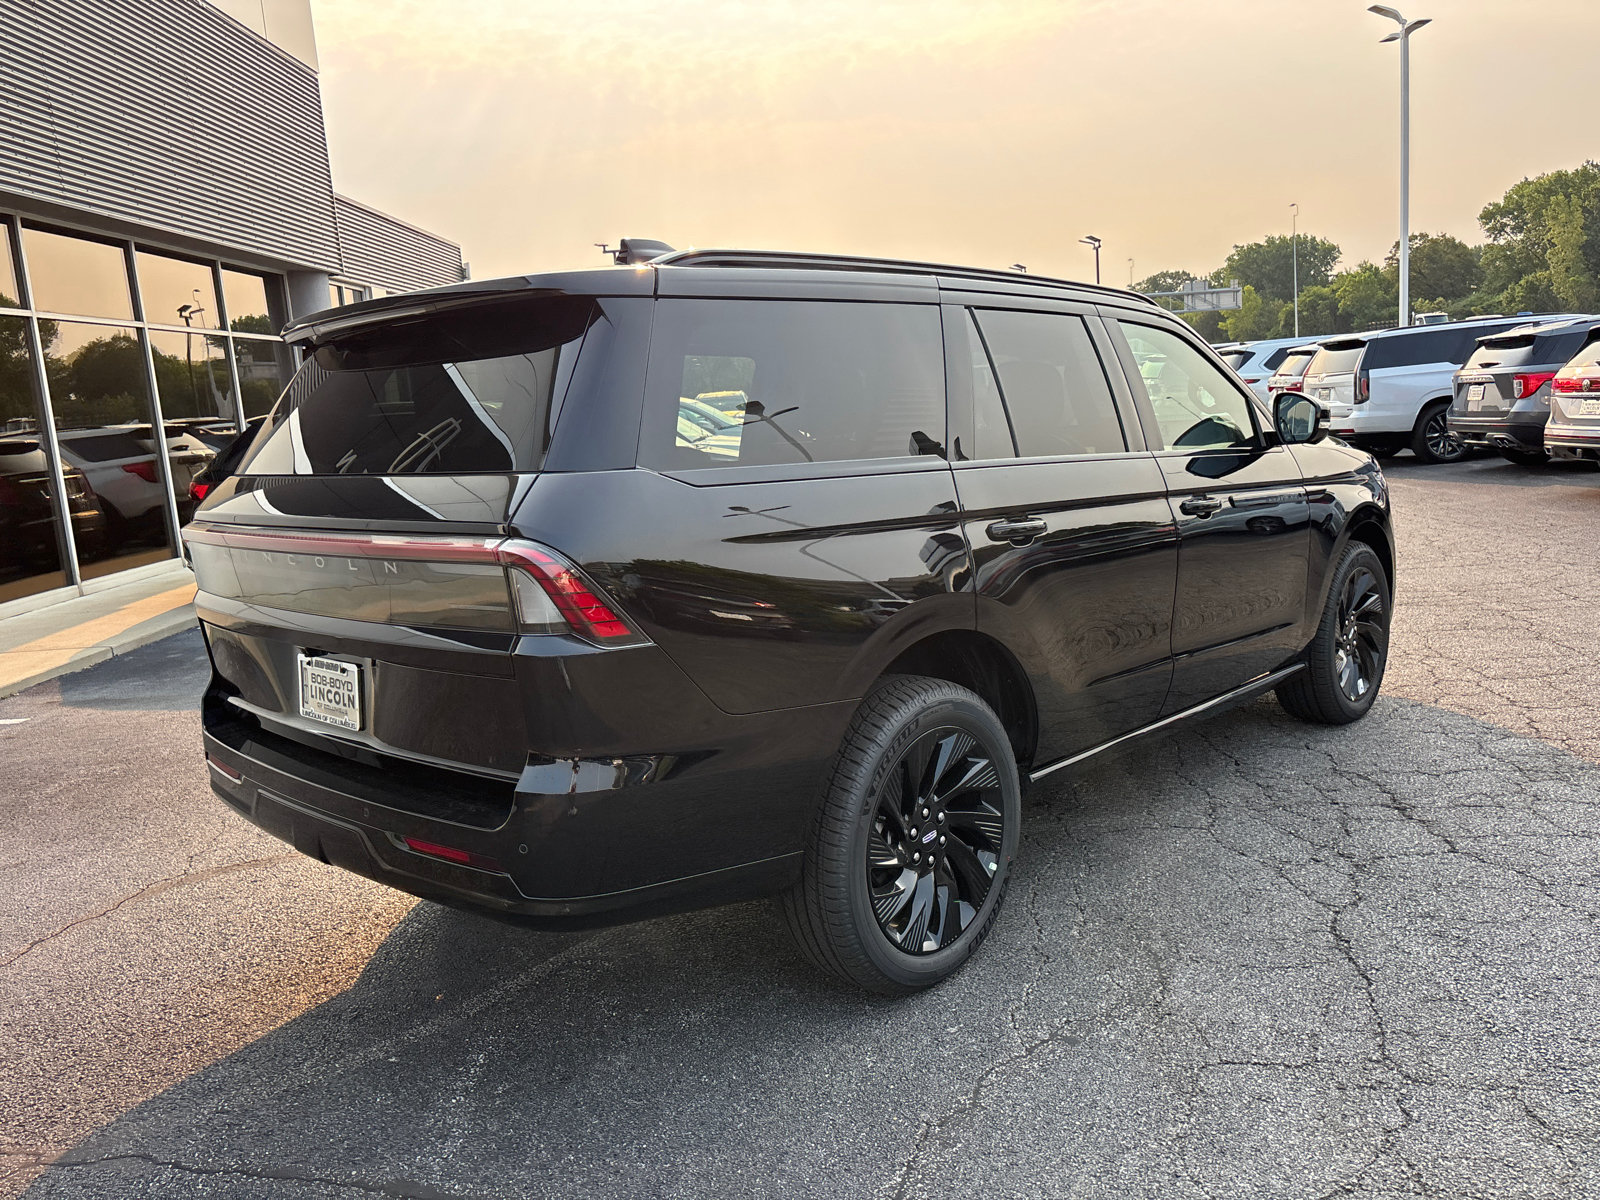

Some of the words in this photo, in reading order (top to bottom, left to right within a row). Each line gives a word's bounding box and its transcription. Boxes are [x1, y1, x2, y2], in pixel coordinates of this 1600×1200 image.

[223, 551, 398, 575] LINCOLN
[311, 673, 353, 693] BOB-BOYD
[310, 685, 355, 709] LINCOLN
[872, 718, 920, 790] MICHELIN
